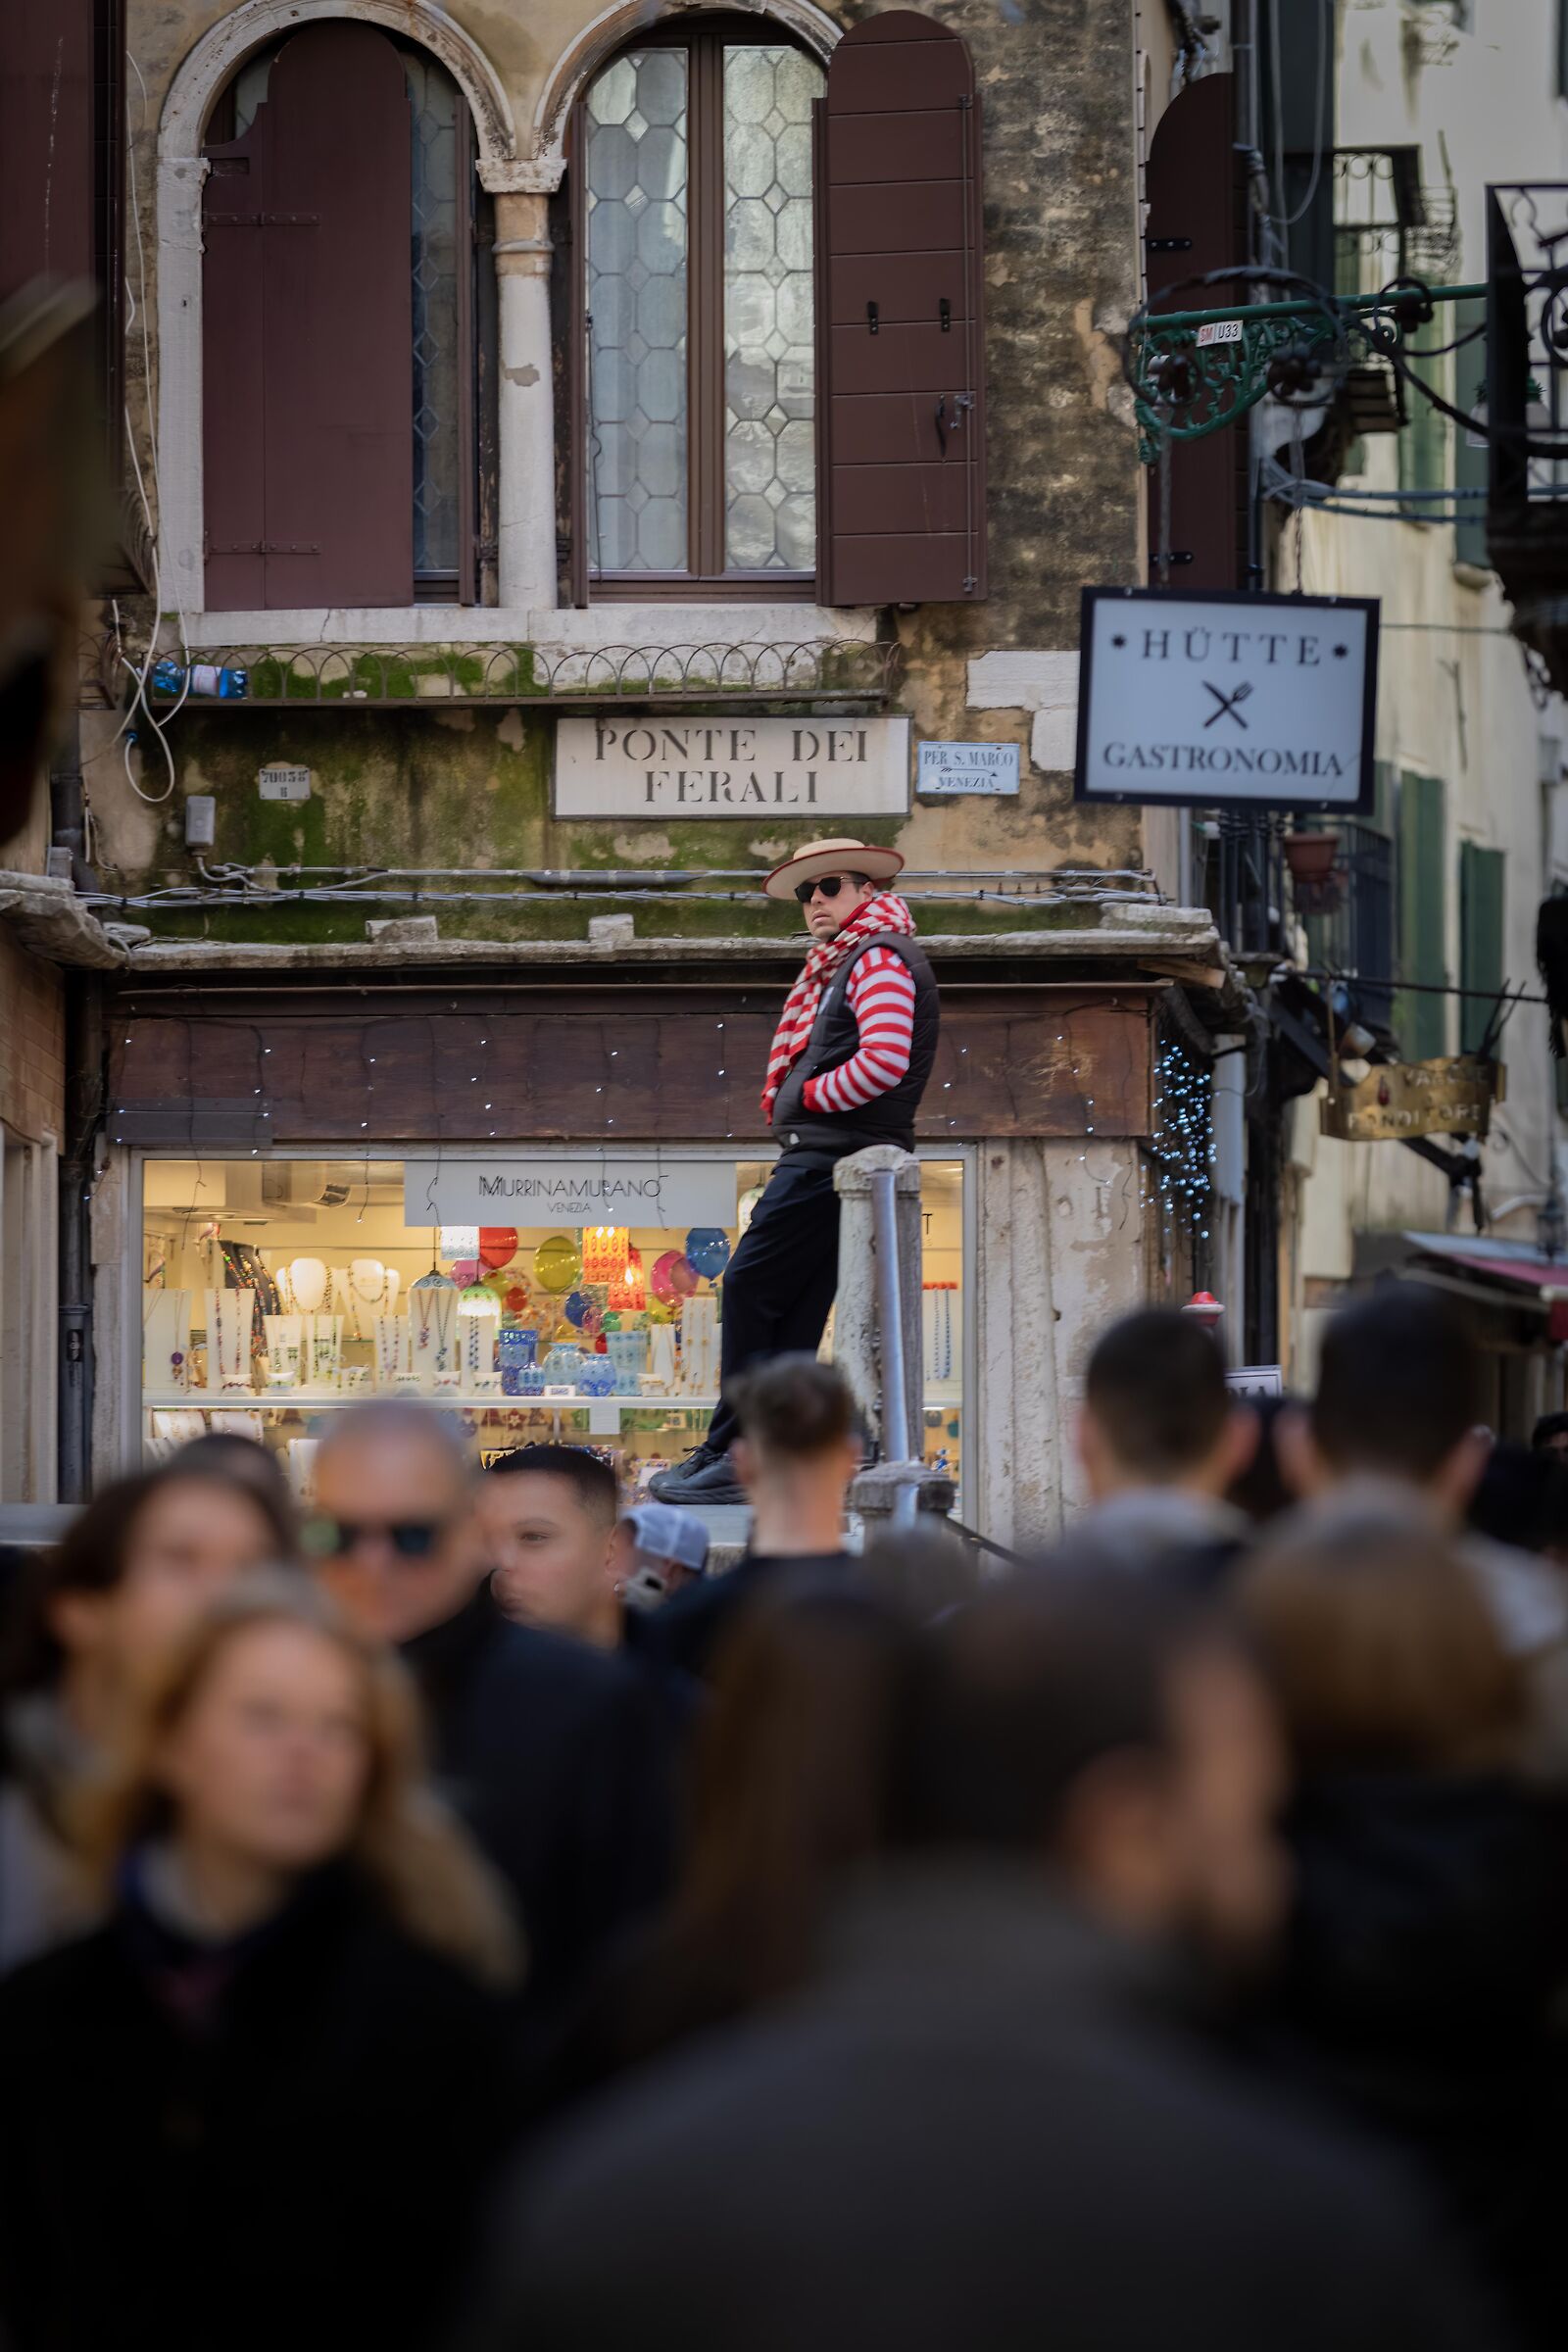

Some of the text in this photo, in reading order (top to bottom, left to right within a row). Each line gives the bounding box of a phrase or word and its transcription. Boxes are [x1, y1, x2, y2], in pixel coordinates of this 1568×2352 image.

[1218, 323, 1239, 339] U33
[1141, 626, 1322, 667] HÜTTE
[595, 728, 869, 762] PONTE DEI
[924, 750, 1013, 767] PER S. MARCO
[1102, 741, 1344, 777] GASTRONOMIA
[644, 770, 818, 804] FERALI
[938, 775, 995, 789] VENEZIA
[547, 1200, 592, 1214] VENEZIA
